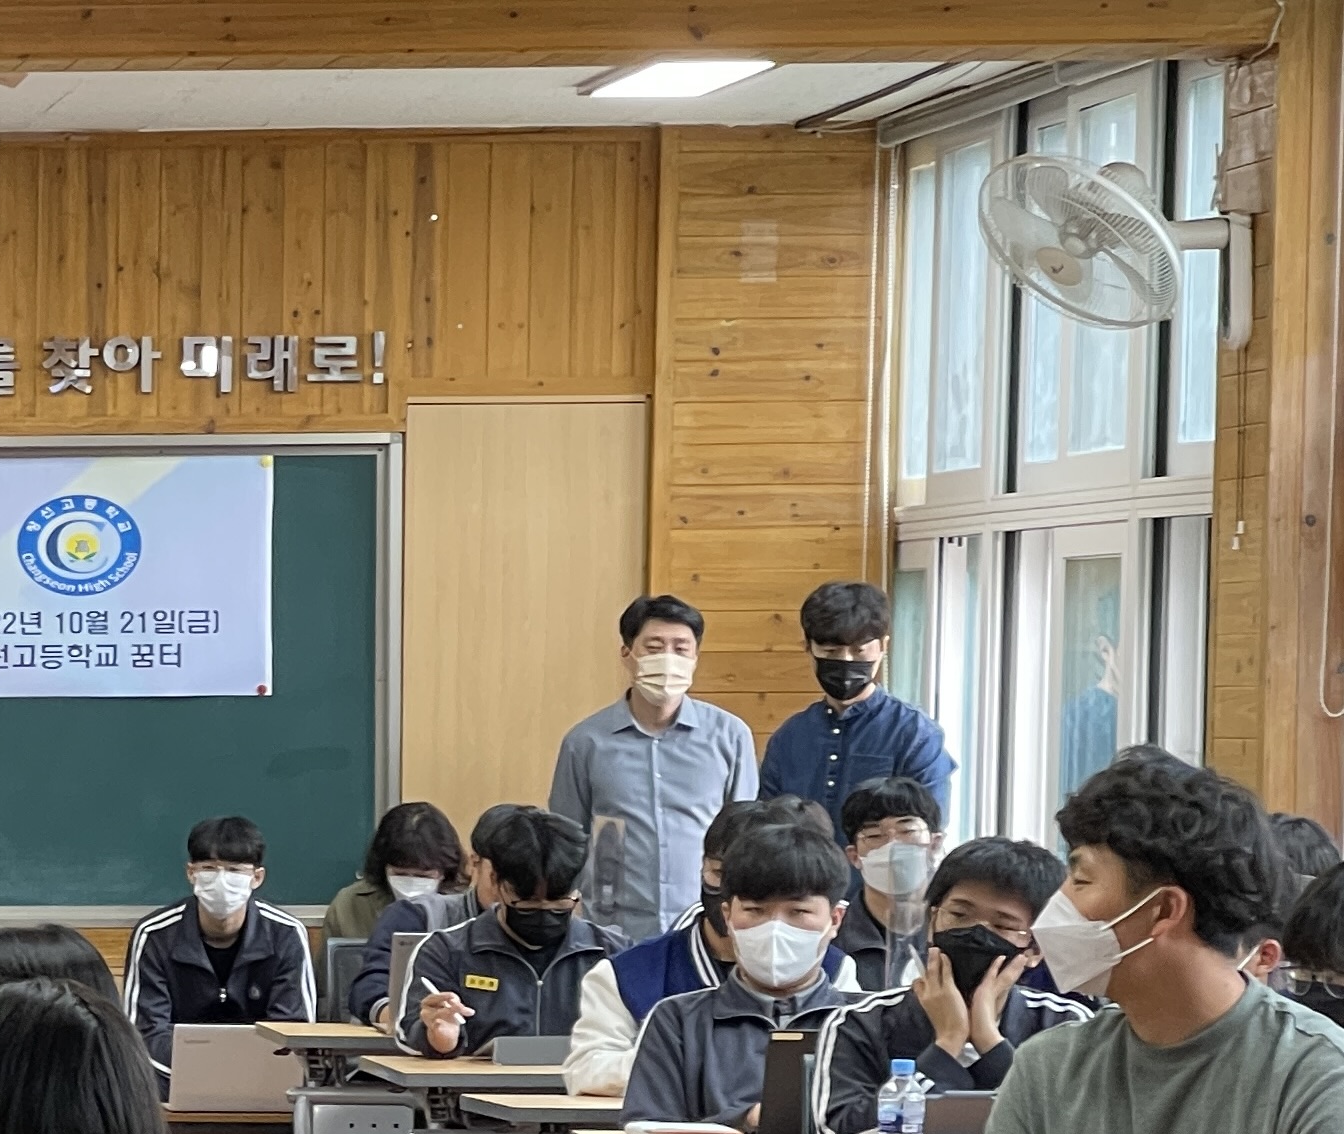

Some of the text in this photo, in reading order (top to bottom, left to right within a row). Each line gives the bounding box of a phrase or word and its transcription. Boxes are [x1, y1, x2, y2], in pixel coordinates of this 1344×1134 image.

[43, 336, 161, 394] 찾아
[180, 330, 386, 394] 미래로!
[55, 610, 109, 635] 10월
[120, 609, 220, 635] 21일(금)
[130, 643, 182, 668] 꿈터
